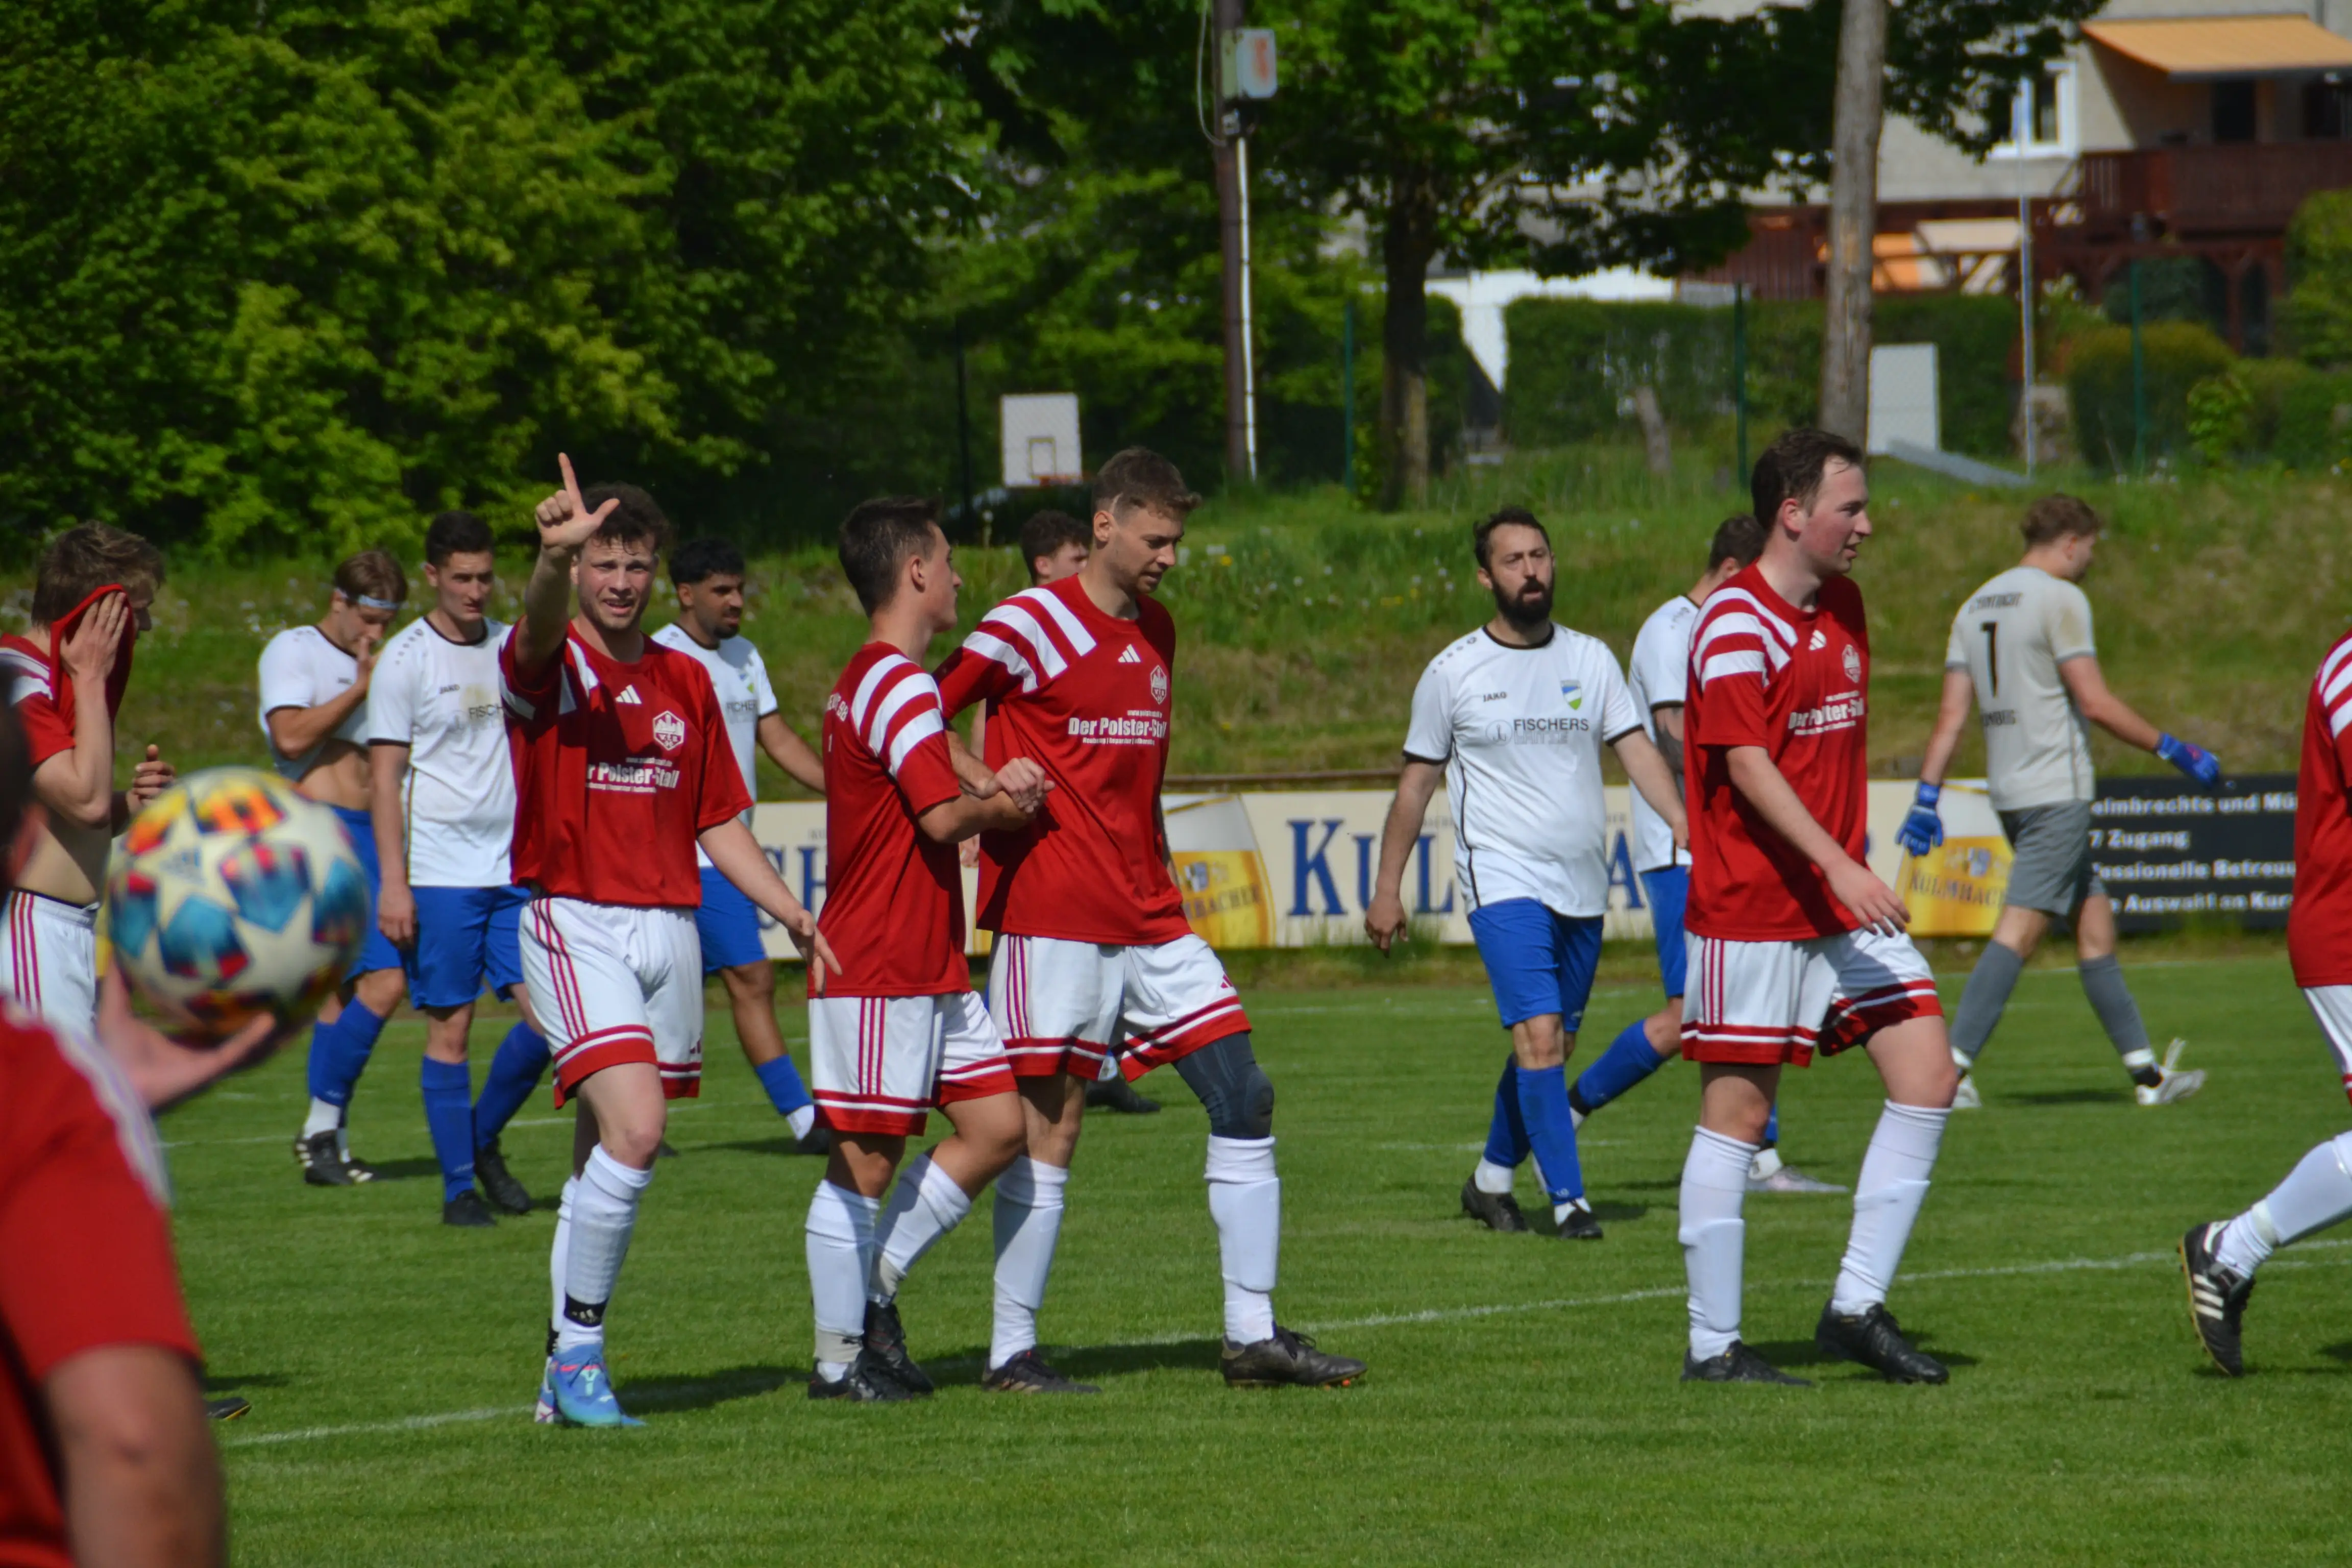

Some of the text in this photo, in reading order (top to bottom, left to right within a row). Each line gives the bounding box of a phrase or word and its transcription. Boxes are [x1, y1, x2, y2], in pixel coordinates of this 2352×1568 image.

[1980, 622, 1998, 699] 1
[1483, 692, 1507, 702] JAKO
[1068, 717, 1097, 736] Der
[1513, 718, 1589, 732] FISCHERS
[597, 762, 680, 789] Polster-Stall
[2091, 795, 2215, 816] elmbrechts
[2217, 793, 2260, 814] und
[2108, 828, 2190, 851] Zugang
[2213, 857, 2296, 879] Betreuu
[2124, 893, 2218, 913] Auswahl
